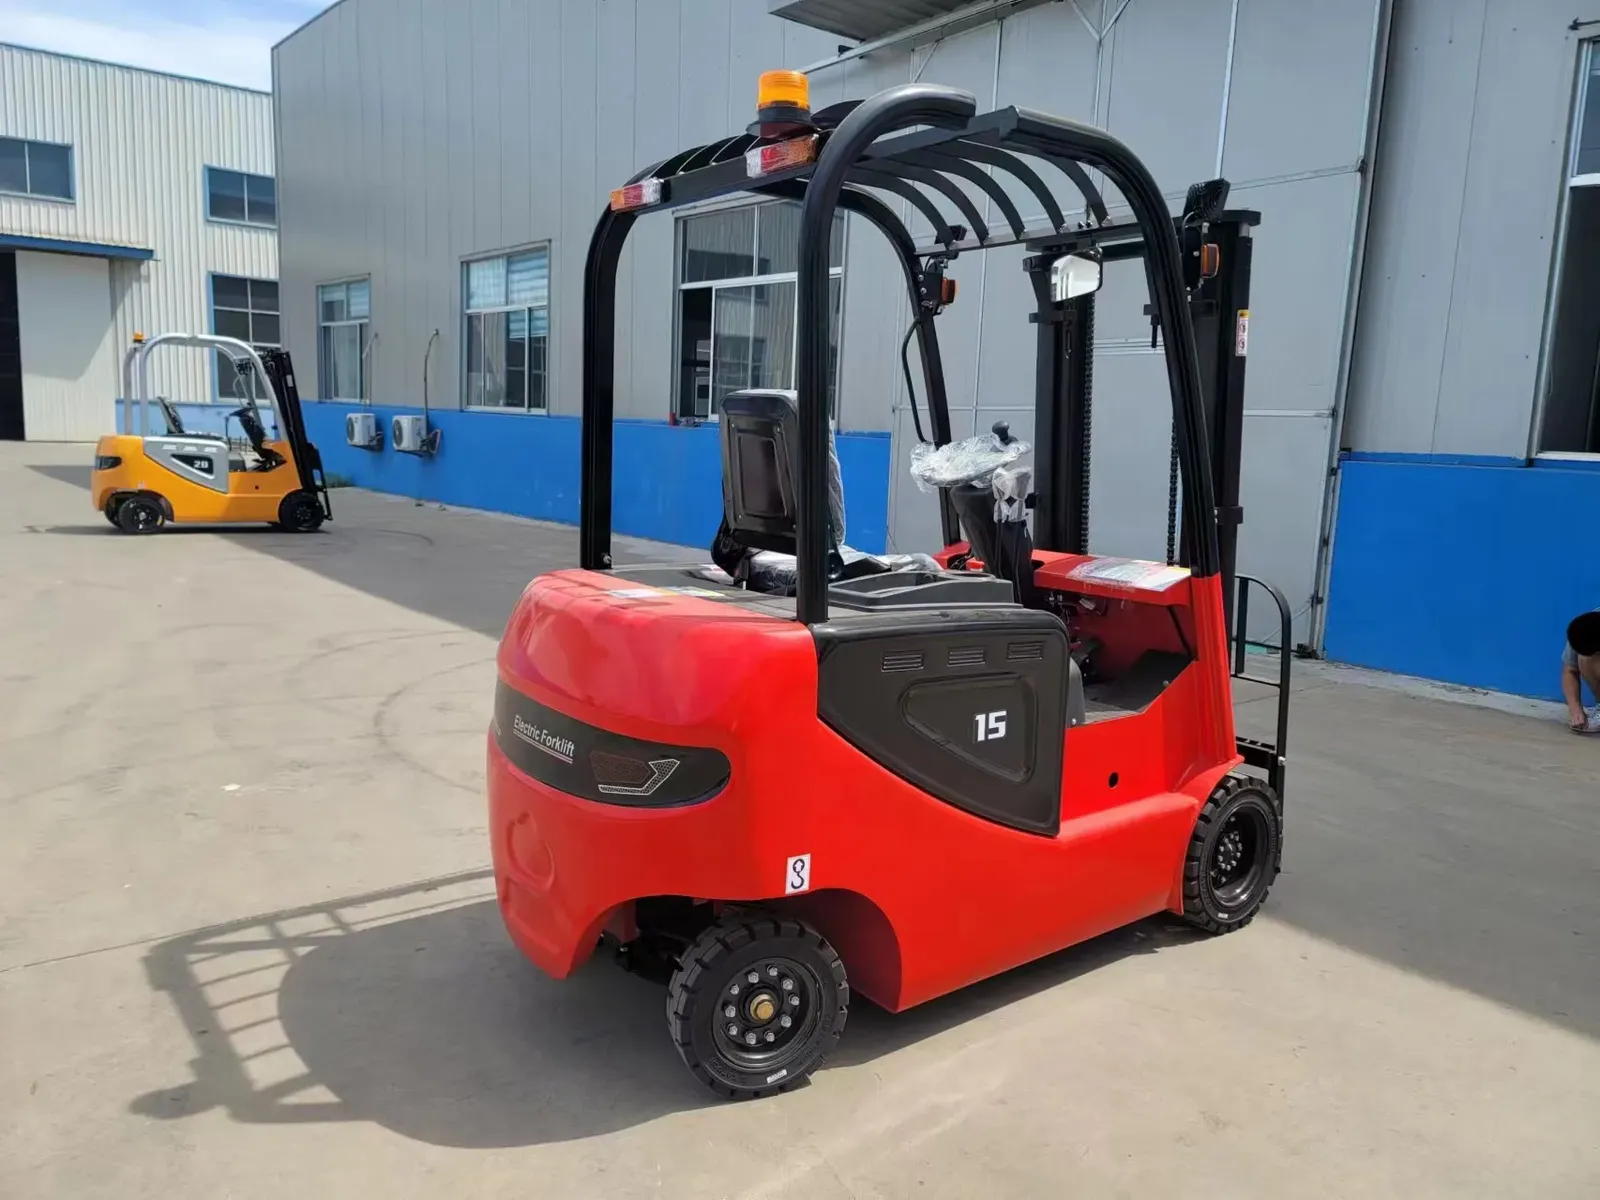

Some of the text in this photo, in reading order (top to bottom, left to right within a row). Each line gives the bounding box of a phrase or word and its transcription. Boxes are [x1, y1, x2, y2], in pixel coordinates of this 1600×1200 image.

[513, 714, 575, 757] Electric Forklift
[975, 710, 1007, 741] 15
